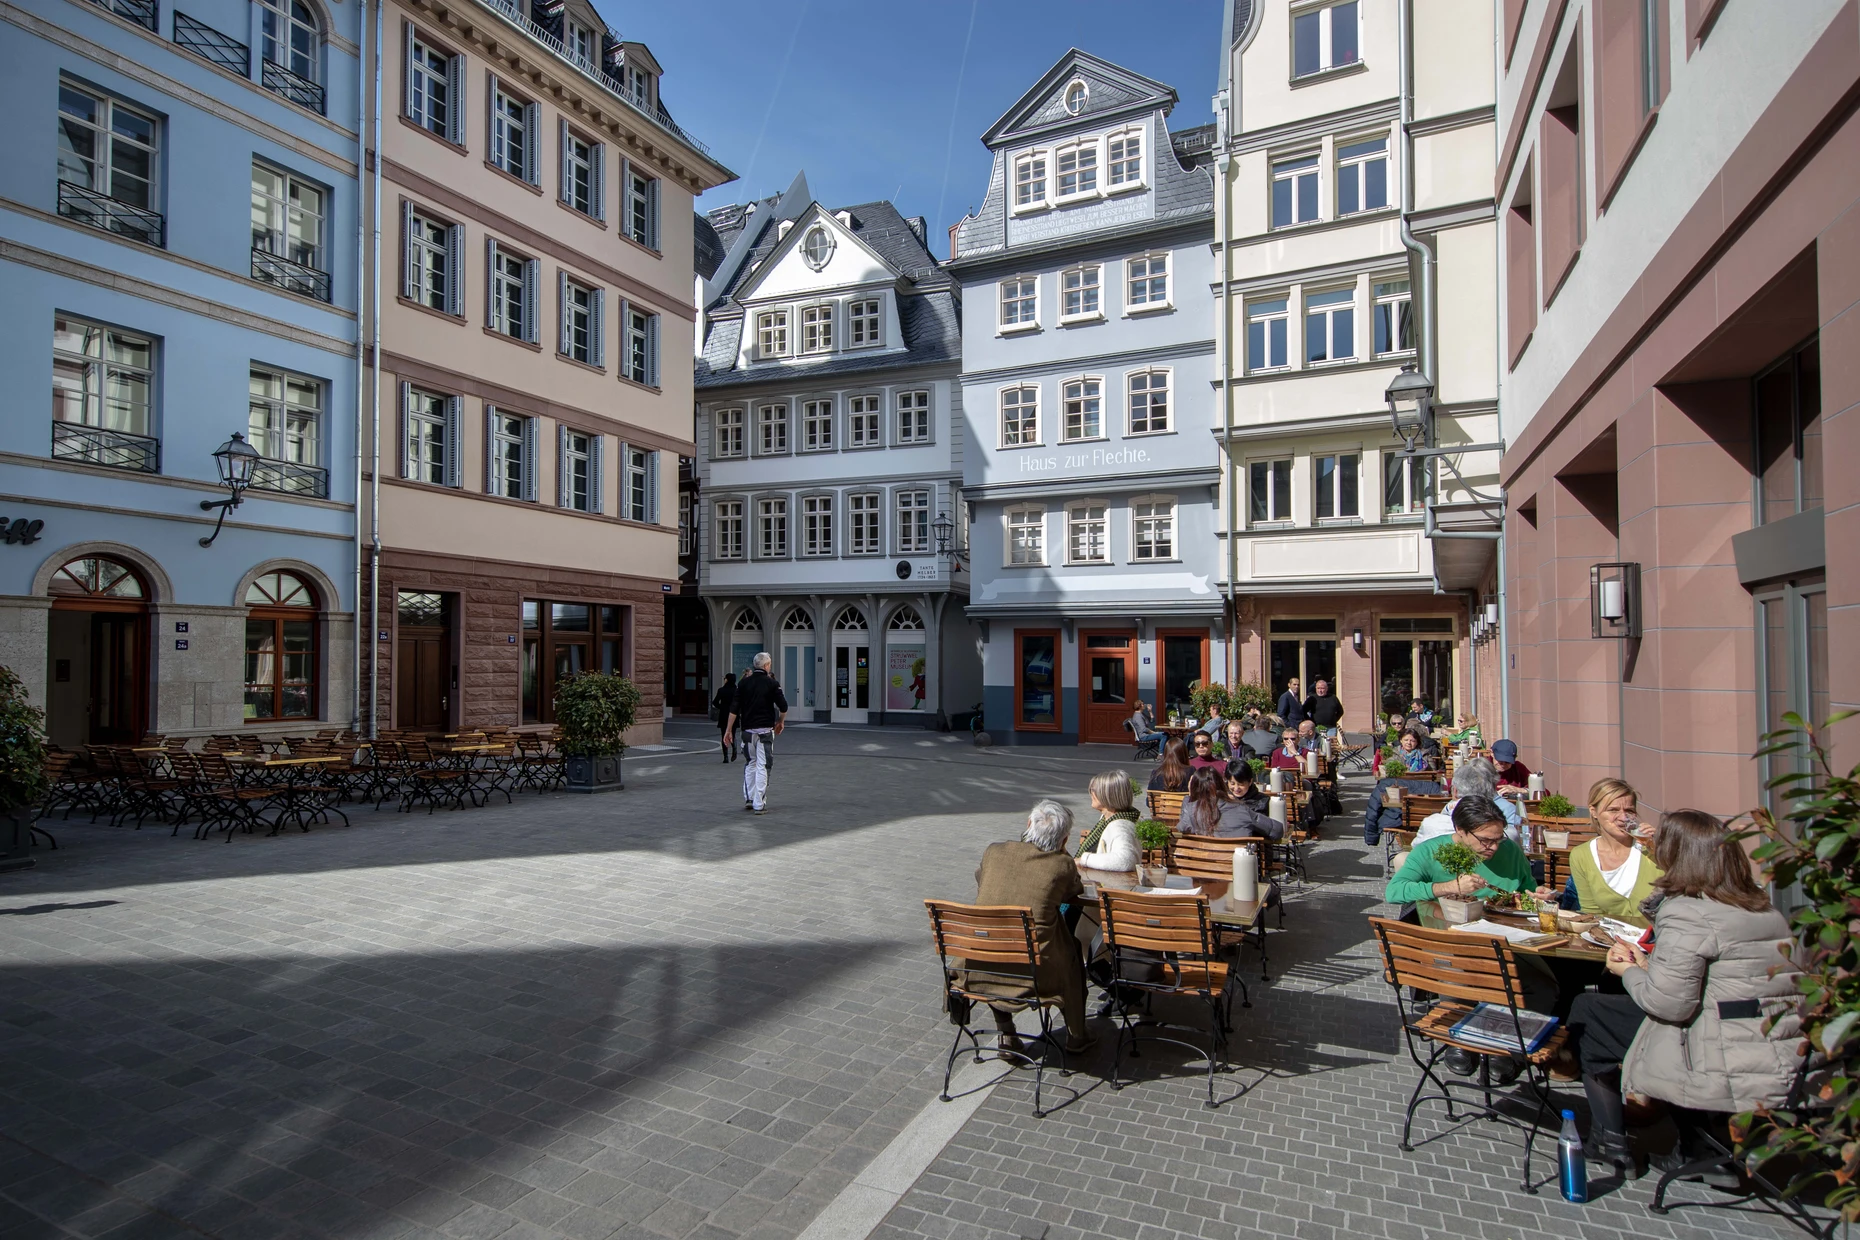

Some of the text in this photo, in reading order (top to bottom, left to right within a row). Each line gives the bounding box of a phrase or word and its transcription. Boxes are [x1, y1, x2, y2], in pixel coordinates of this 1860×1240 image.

[1011, 214, 1045, 228] FRANKFURT
[1048, 209, 1064, 220] LIEGT
[1087, 211, 1098, 220] ZUM
[1100, 206, 1122, 217] BESSER
[1123, 201, 1147, 213] MACHEN
[1030, 227, 1058, 239] VERSTAND
[1095, 216, 1112, 226] KANN
[1112, 212, 1131, 223] JEDER
[1132, 210, 1145, 219] ESEL
[1020, 446, 1150, 471] Haus zur Flechte.
